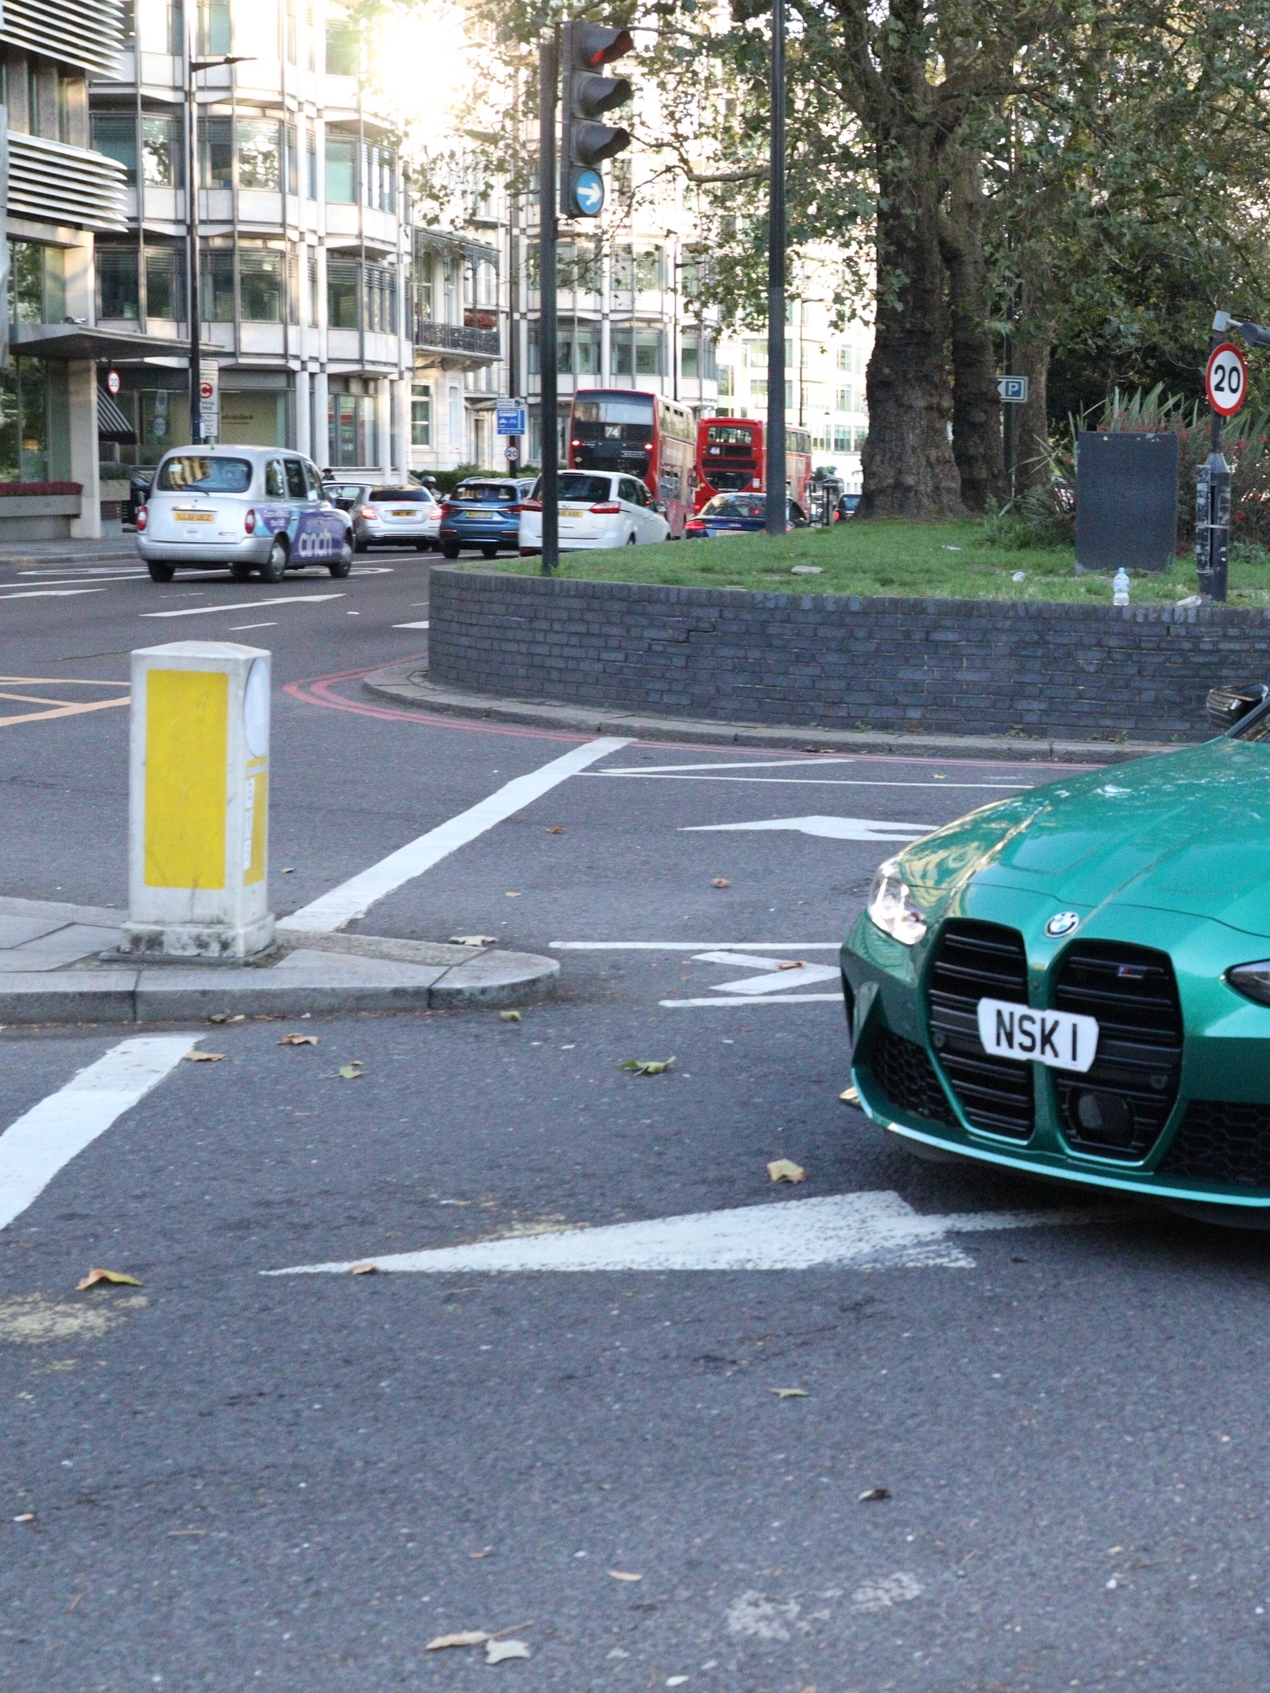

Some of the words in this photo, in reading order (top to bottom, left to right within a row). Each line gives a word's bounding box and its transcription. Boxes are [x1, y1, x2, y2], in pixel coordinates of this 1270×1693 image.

[1214, 365, 1240, 393] 20
[1008, 382, 1019, 395] P
[605, 426, 620, 438] 74
[507, 450, 518, 458] 20
